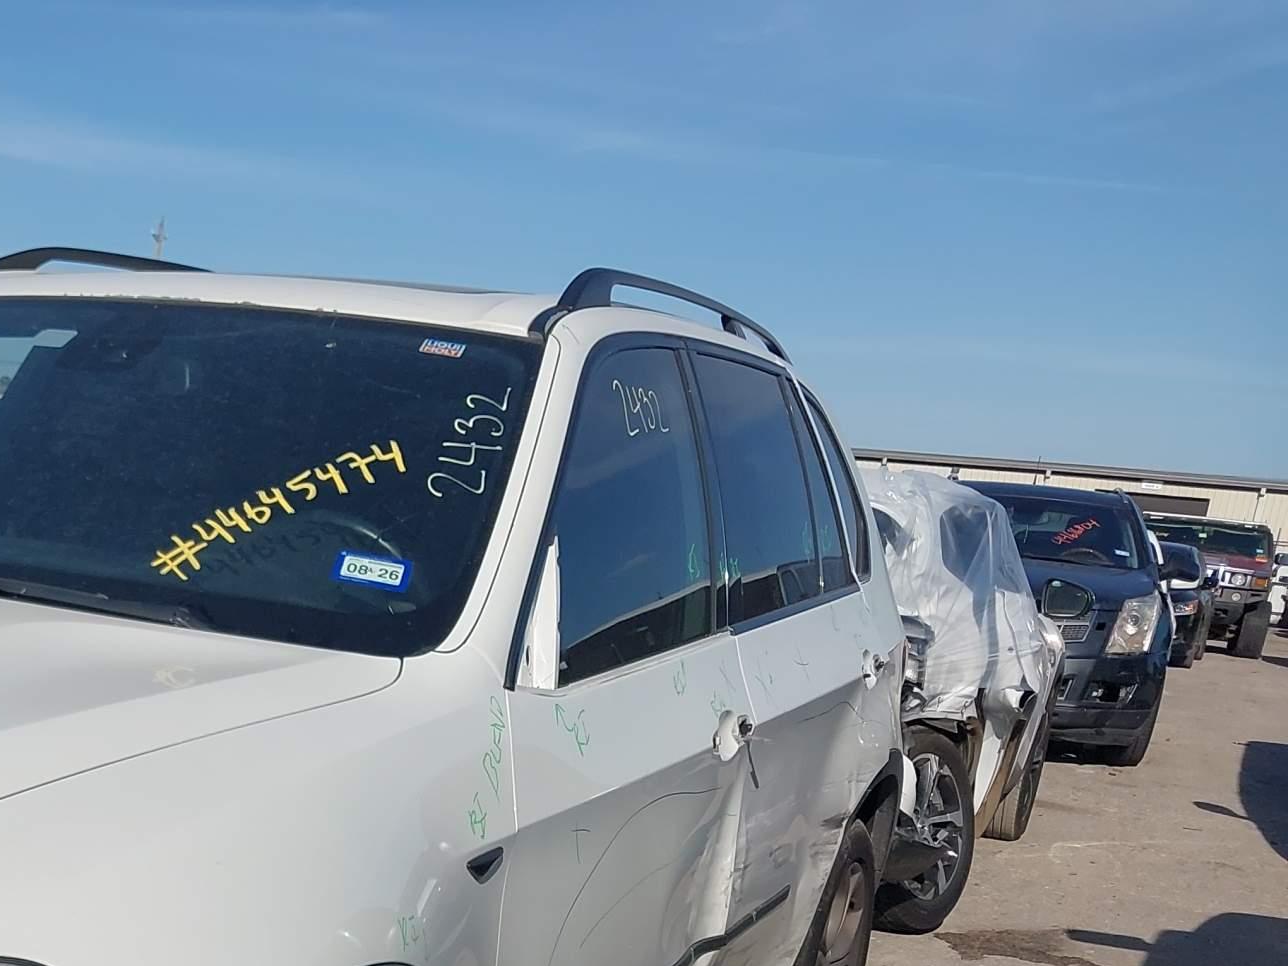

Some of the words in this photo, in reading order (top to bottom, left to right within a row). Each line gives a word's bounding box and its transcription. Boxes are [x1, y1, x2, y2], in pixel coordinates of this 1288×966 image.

[427, 387, 513, 499] 2432
[612, 378, 671, 438] 2432
[150, 439, 406, 583] #44645474
[347, 563, 369, 575] 08
[377, 568, 400, 581] 26
